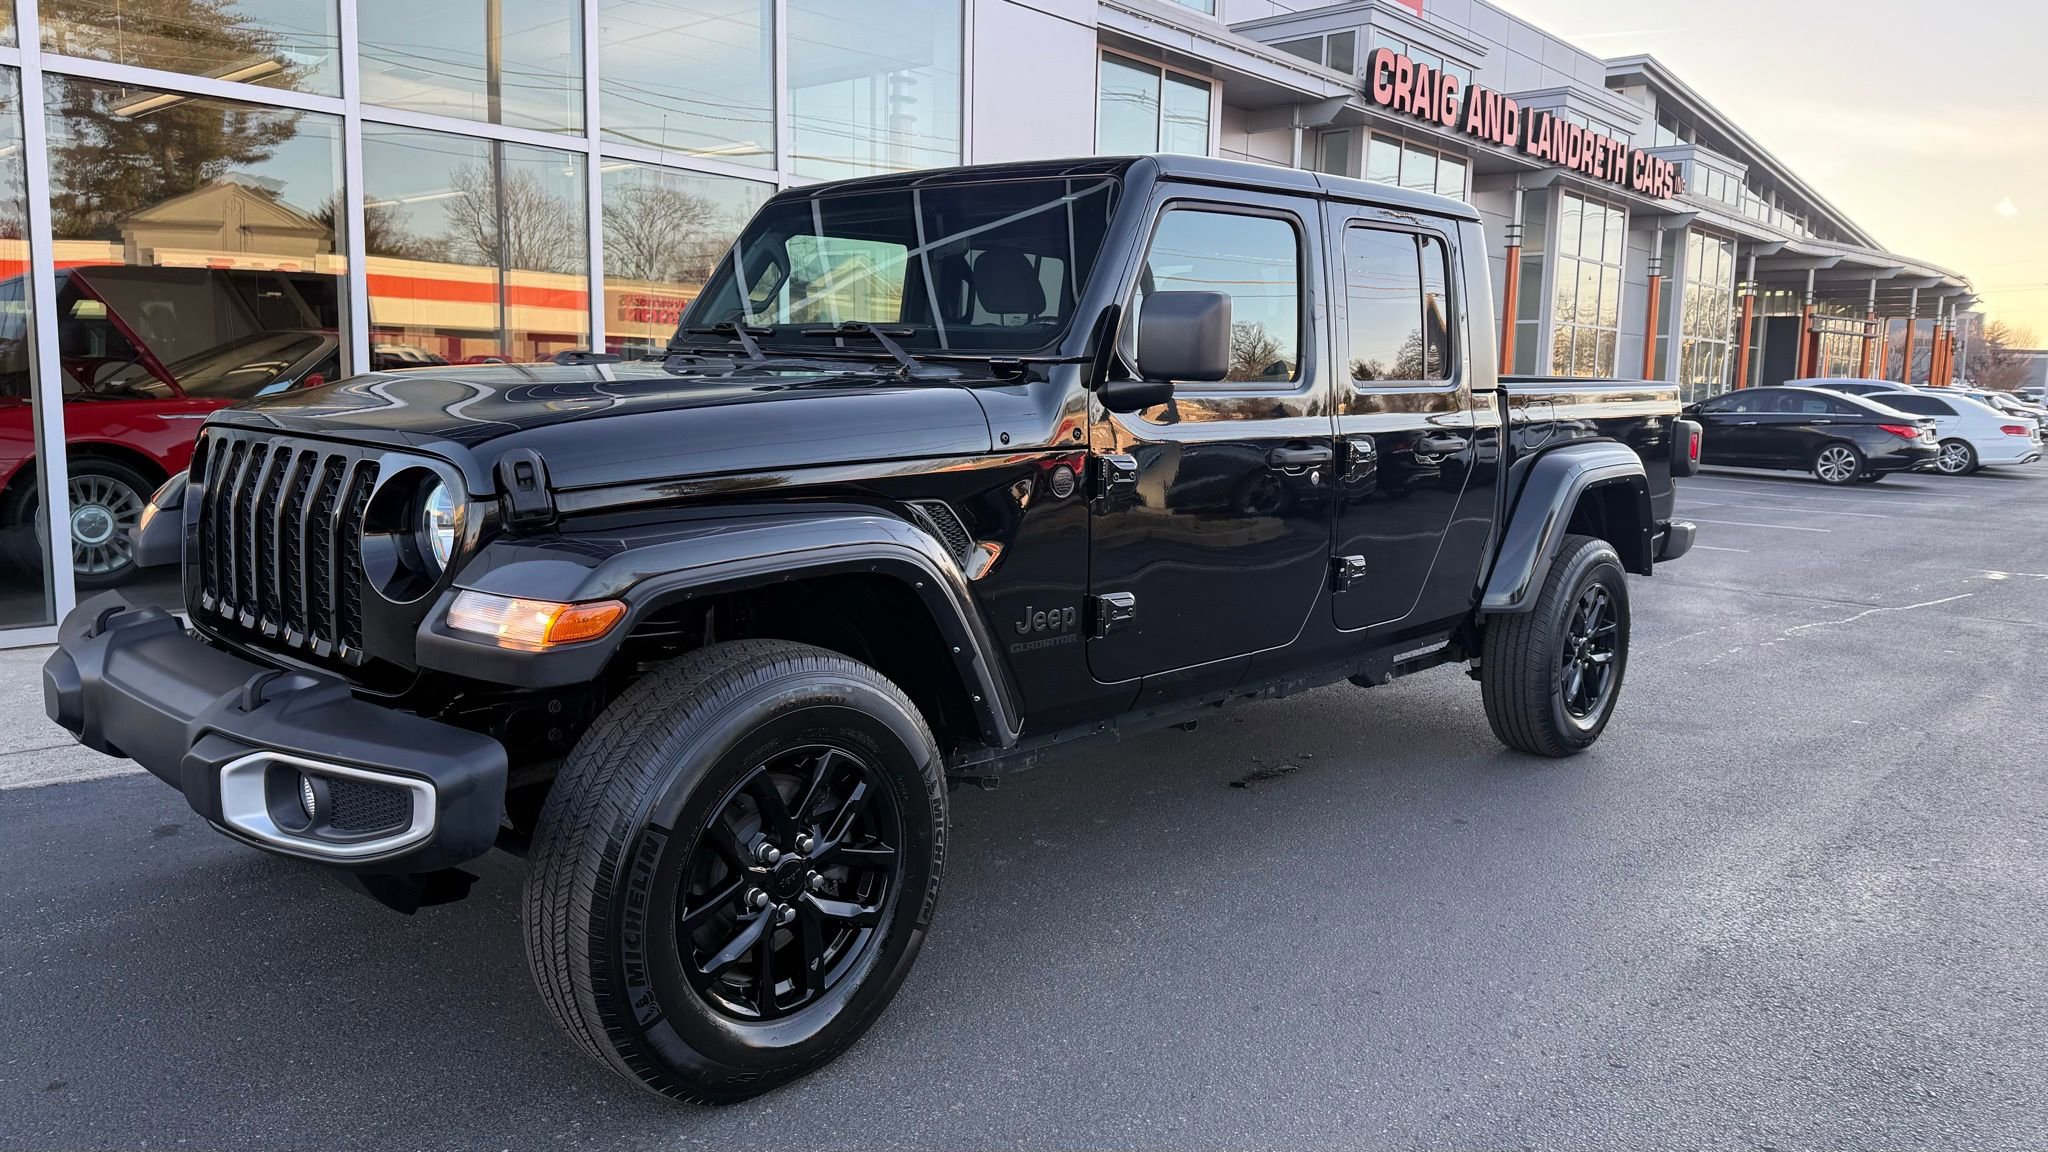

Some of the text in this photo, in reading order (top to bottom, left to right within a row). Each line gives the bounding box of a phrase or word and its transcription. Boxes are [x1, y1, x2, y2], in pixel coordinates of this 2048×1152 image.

[1370, 47, 1460, 128] CRAIG
[1464, 83, 1519, 147] AND
[1524, 106, 1629, 186] LANDRETH
[1631, 149, 1675, 200] CARS
[1010, 633, 1077, 653] GLADIATOR
[1015, 606, 1077, 635] Jeep
[623, 834, 662, 988] MICHELIN
[922, 797, 944, 921] MICHELIN
